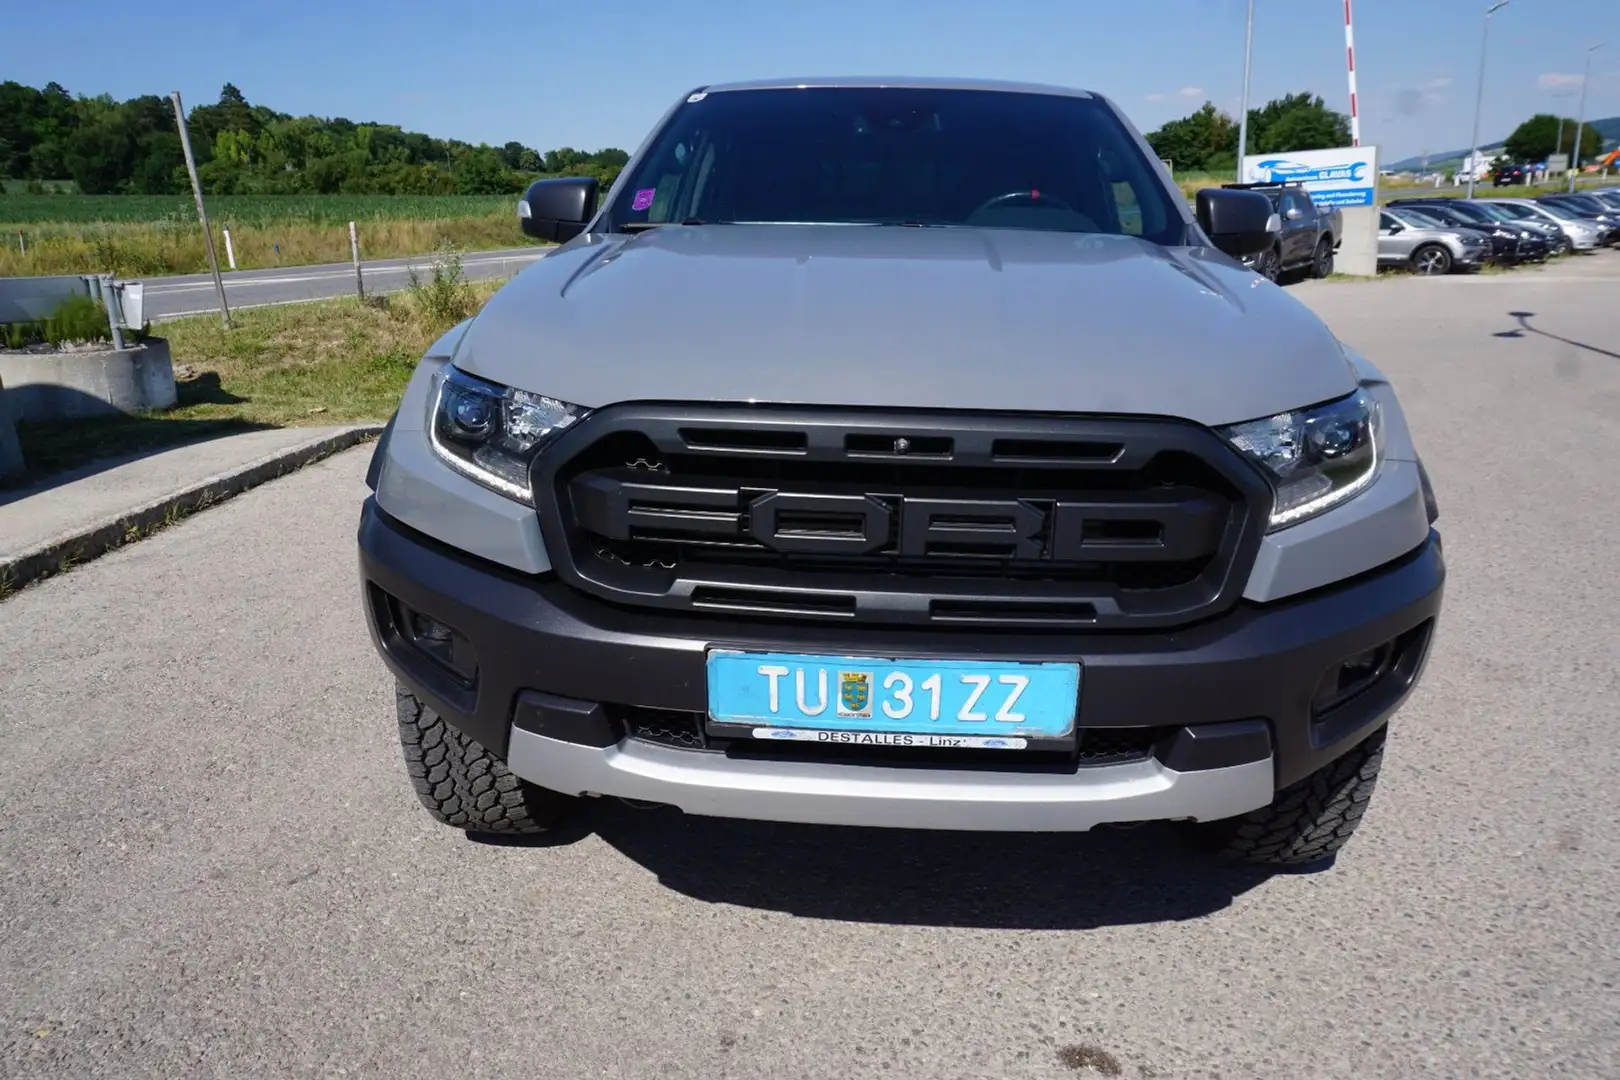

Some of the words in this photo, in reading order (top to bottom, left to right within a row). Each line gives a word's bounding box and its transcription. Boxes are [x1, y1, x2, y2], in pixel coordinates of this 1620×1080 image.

[572, 481, 1222, 562] FORD
[757, 665, 828, 716] TU
[881, 670, 943, 721] 31
[957, 673, 1031, 723] ZZ
[818, 731, 913, 745] DESTALLES
